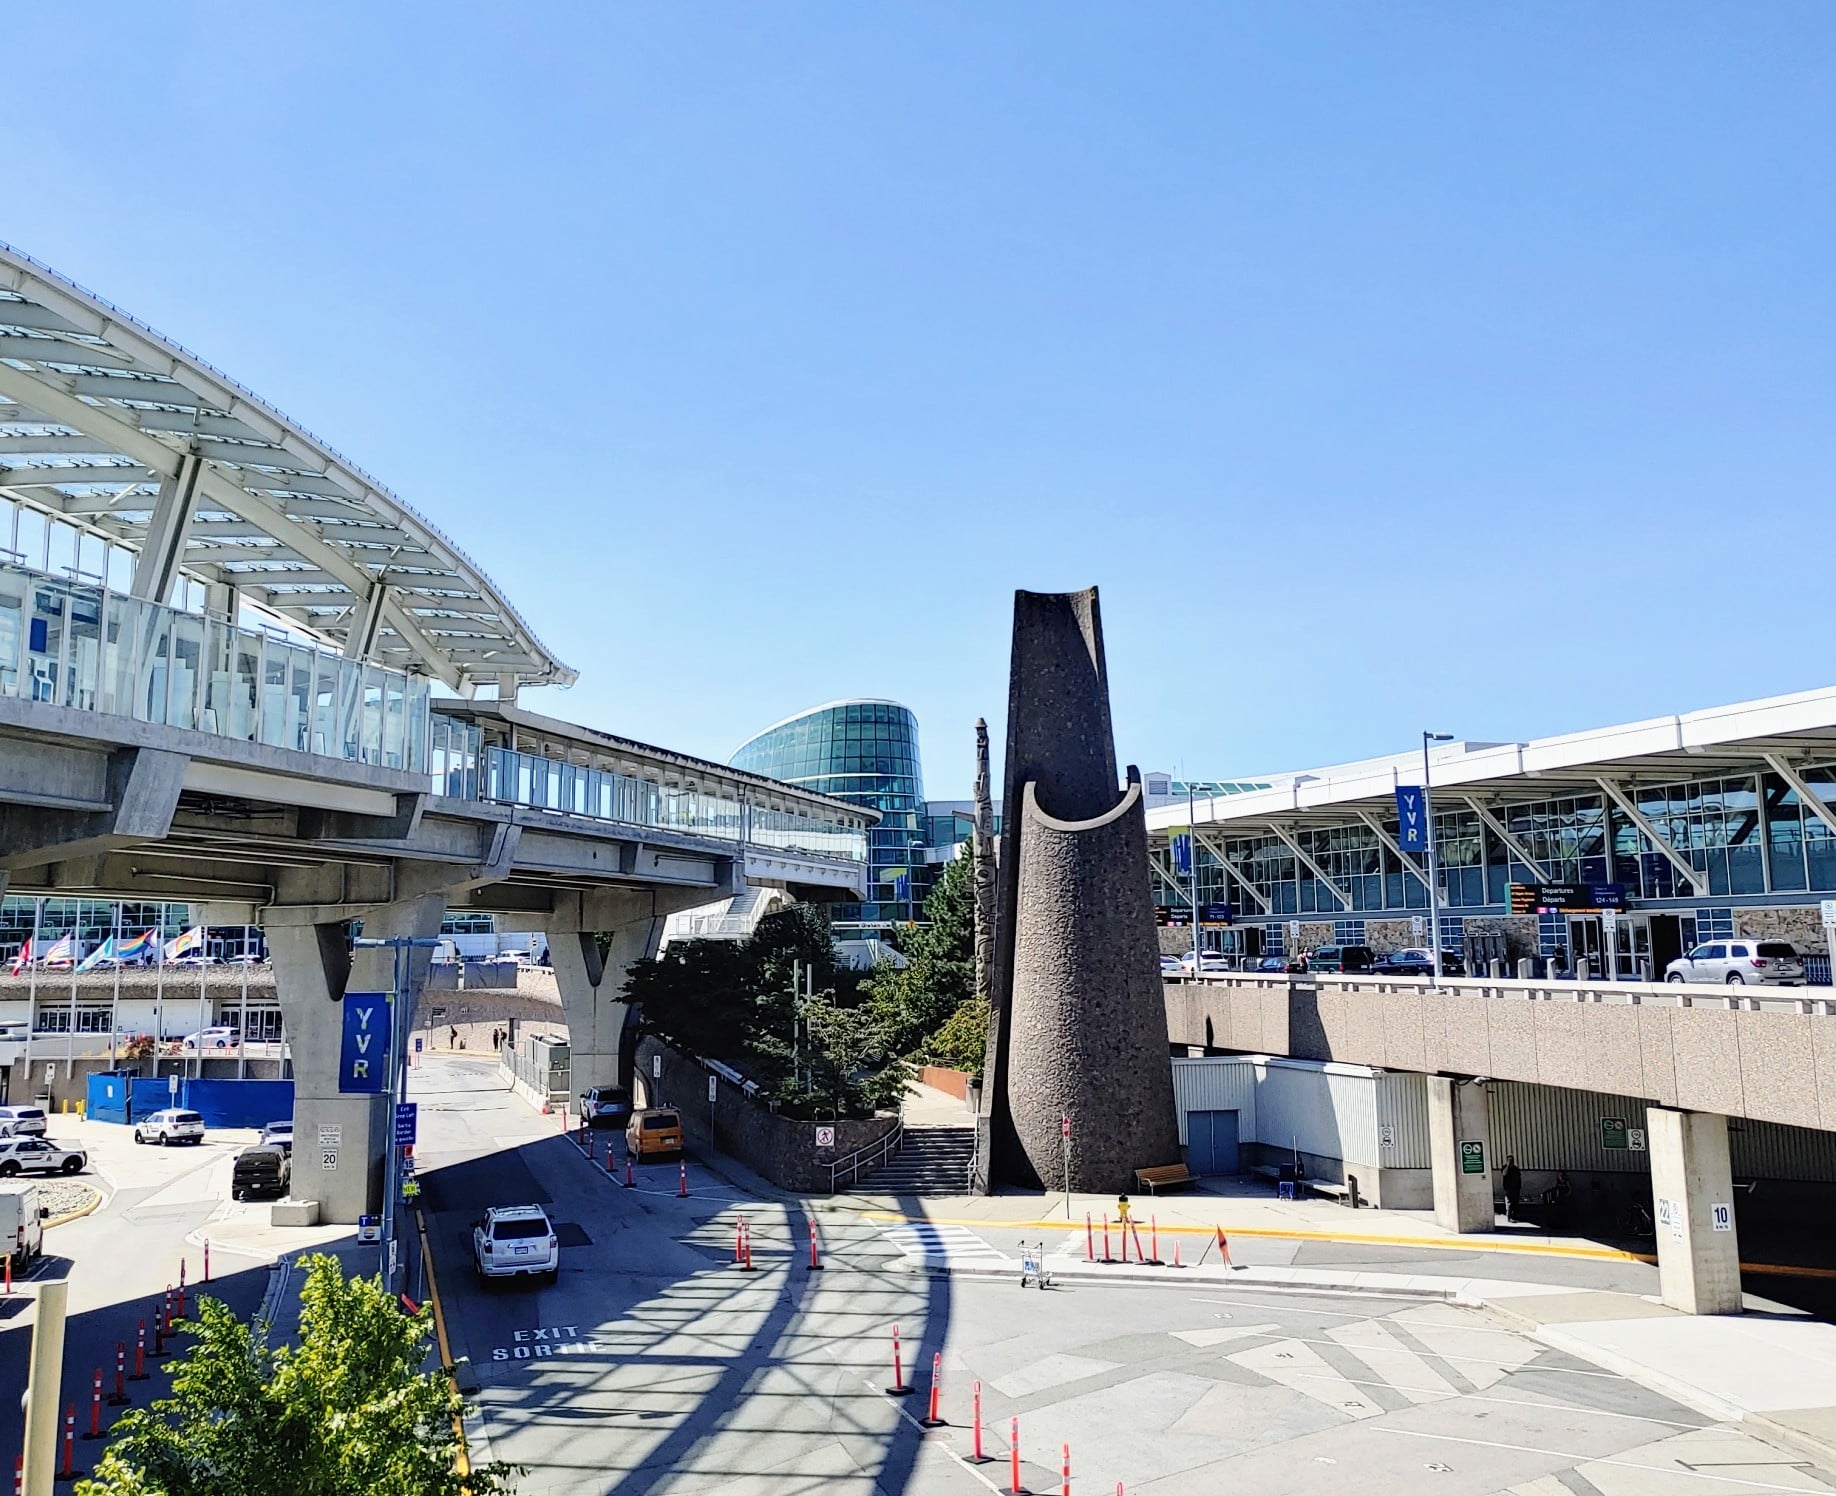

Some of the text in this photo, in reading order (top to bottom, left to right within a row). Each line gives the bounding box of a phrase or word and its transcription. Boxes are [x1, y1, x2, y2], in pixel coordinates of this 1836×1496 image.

[1403, 794, 1418, 842] YVR
[353, 1007, 374, 1078] YVR
[323, 1154, 336, 1164] 20
[405, 1160, 414, 1168] 15
[361, 1216, 368, 1226] T
[1714, 1207, 1728, 1223] 10
[513, 1326, 579, 1342] EXIT
[492, 1340, 607, 1360] SORTIE
